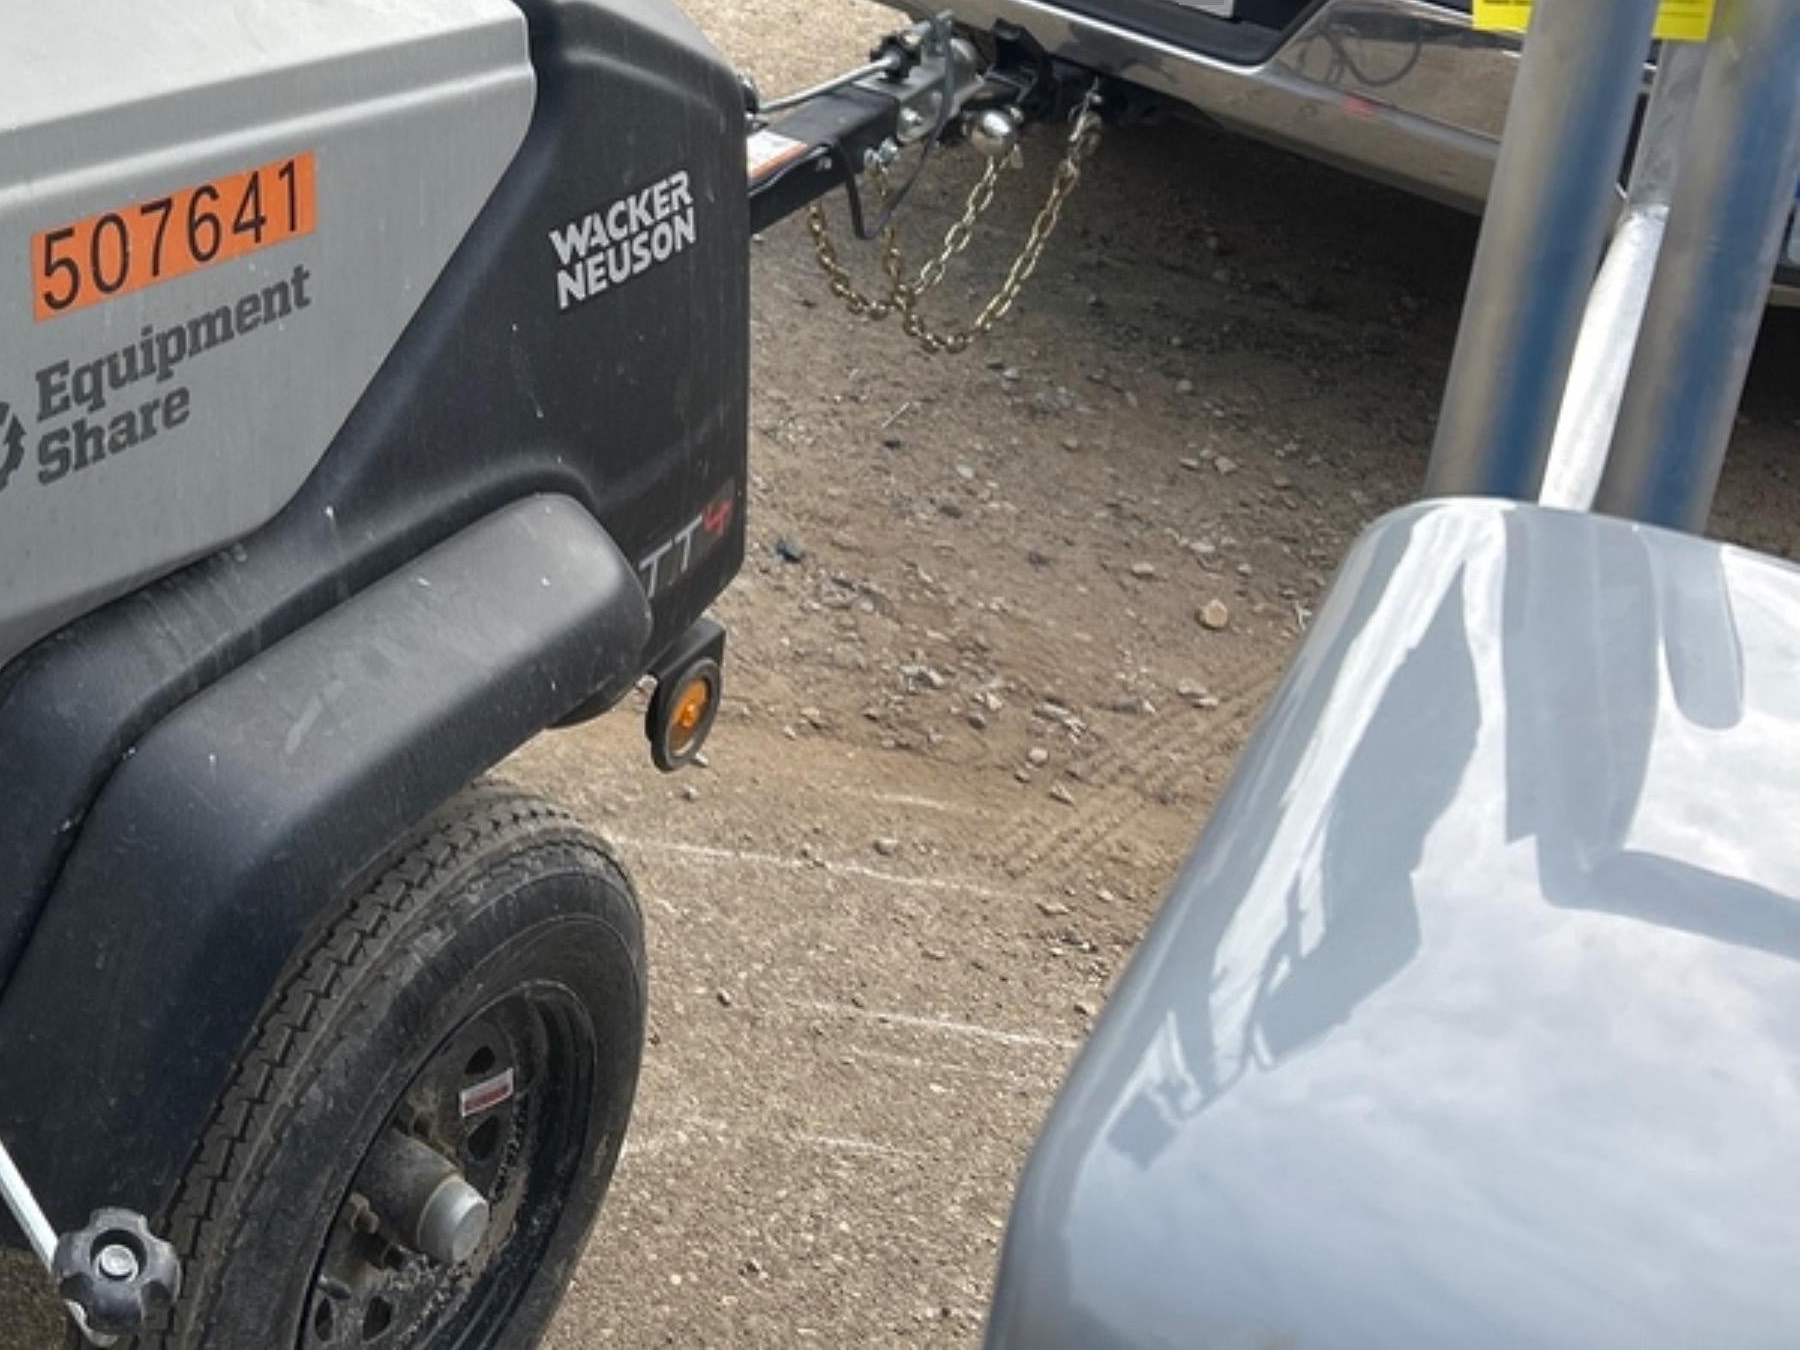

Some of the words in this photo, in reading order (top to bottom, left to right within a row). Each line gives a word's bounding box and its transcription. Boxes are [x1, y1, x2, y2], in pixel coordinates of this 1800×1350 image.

[41, 161, 307, 313] 507641
[547, 169, 693, 267] WACKER
[556, 206, 696, 309] NEUSON
[33, 264, 311, 422] Equipment
[35, 384, 191, 487] Share
